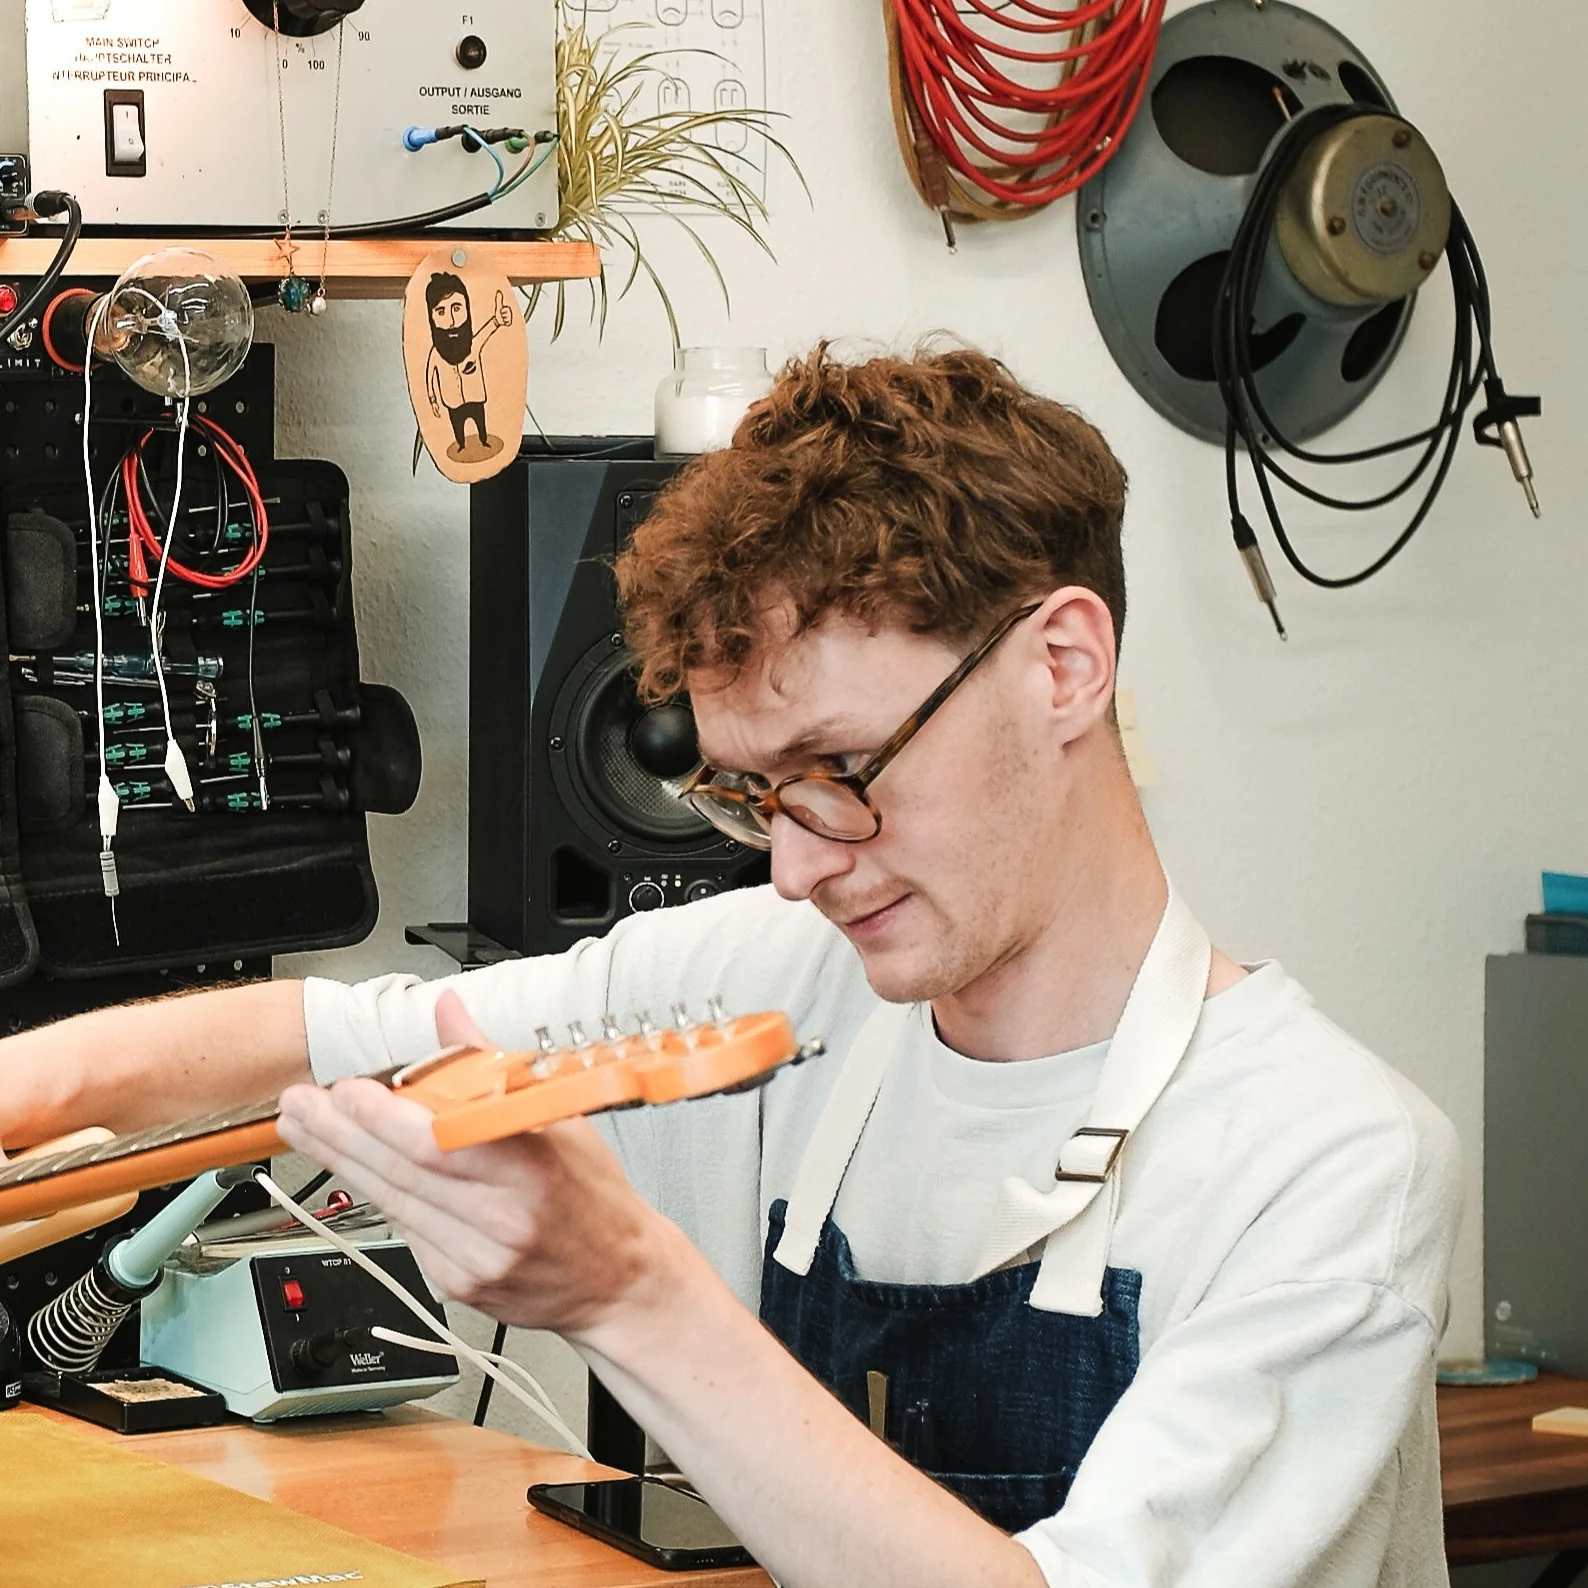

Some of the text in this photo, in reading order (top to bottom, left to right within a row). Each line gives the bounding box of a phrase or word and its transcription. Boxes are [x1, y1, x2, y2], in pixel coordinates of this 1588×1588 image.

[462, 14, 475, 26] F1
[230, 28, 242, 39] 10
[358, 30, 371, 42] 90
[85, 36, 114, 48] MAIN
[282, 59, 289, 70] 0
[308, 59, 326, 71] 100
[419, 86, 462, 98] OUTPUT
[470, 87, 522, 99] AUSGANG
[451, 103, 490, 116] SORTIE
[321, 1259, 342, 1267] WTCP
[349, 1351, 381, 1366] Weller
